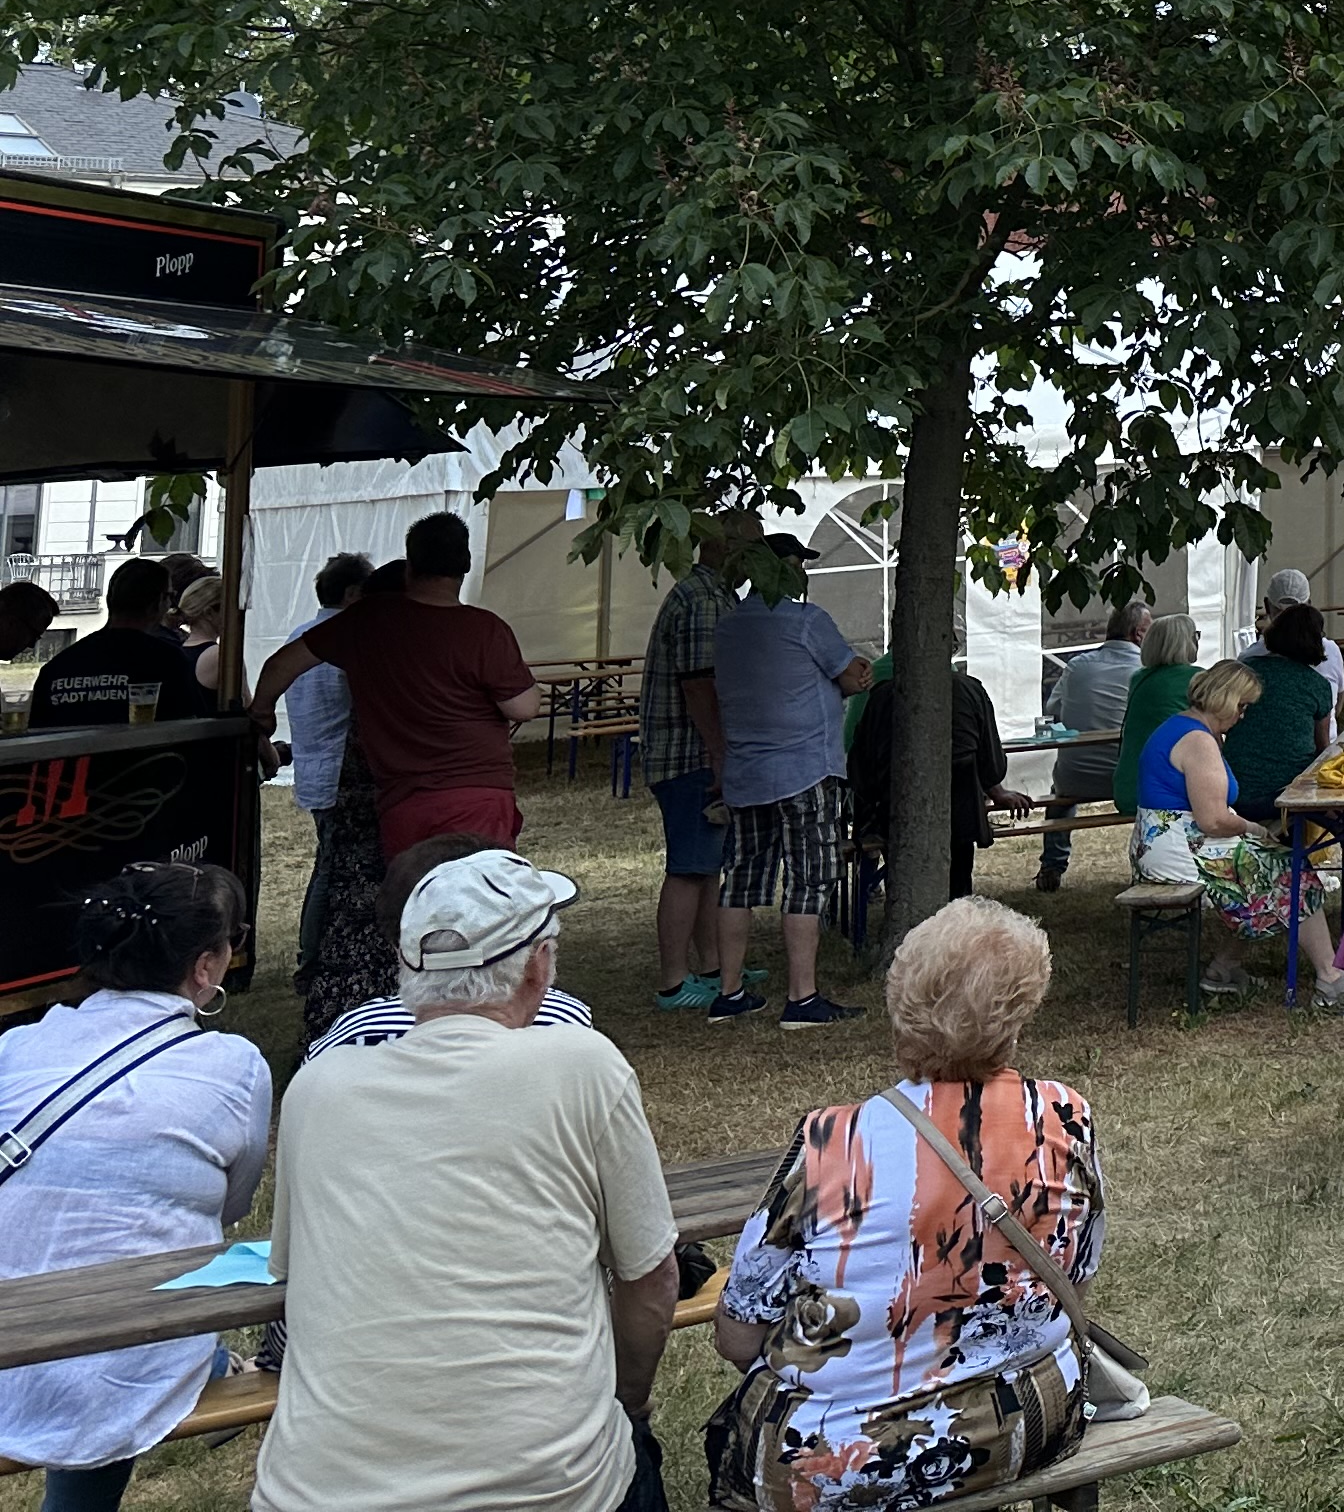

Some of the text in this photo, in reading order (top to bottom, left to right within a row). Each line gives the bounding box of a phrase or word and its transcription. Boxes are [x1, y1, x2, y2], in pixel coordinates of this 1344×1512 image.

[155, 252, 194, 277] Plopp
[51, 674, 129, 692] FEUERWEHR
[87, 689, 127, 701] NAUEN
